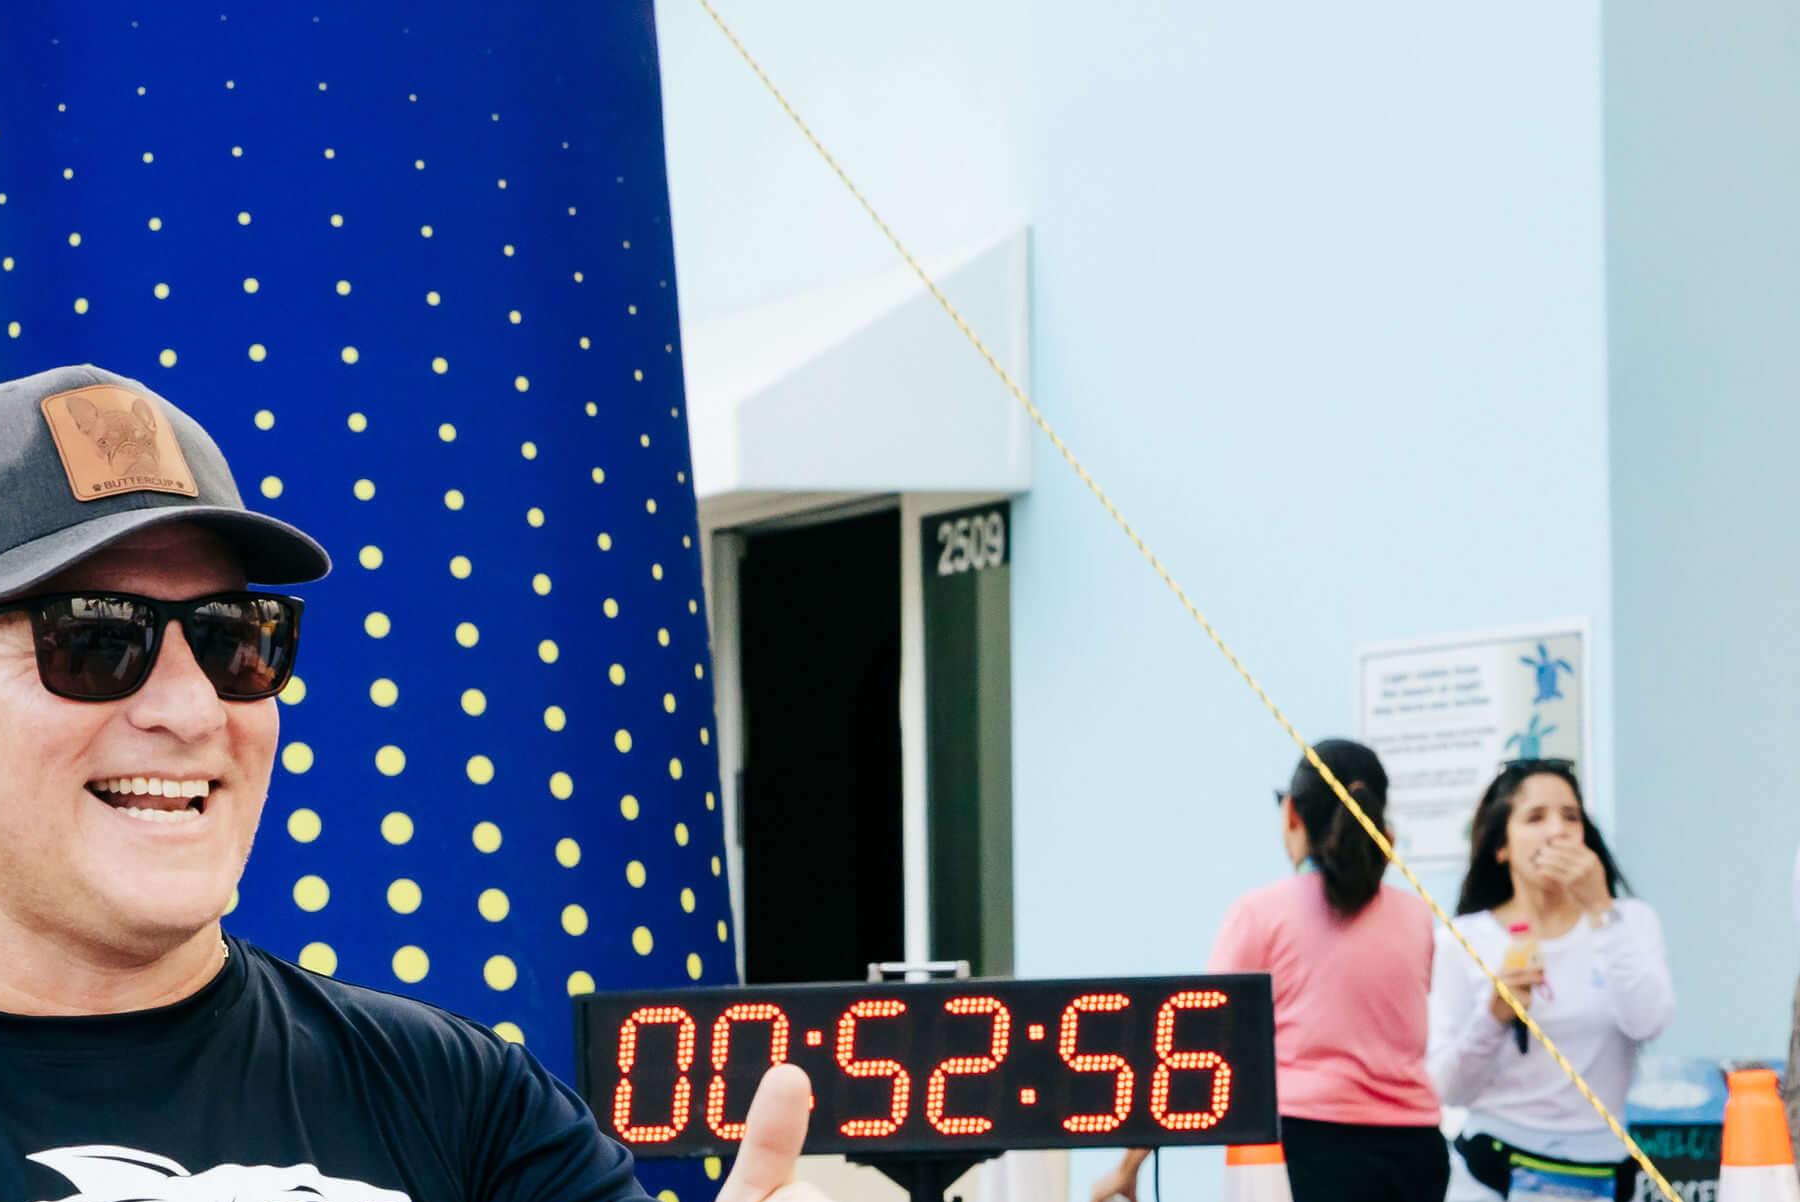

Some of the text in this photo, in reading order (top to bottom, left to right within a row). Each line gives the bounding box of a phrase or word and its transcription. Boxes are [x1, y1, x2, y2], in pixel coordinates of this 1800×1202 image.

[103, 476, 174, 490] BUTTERCUP
[936, 510, 1006, 577] 2509
[612, 990, 1232, 1144] 00:52:56
